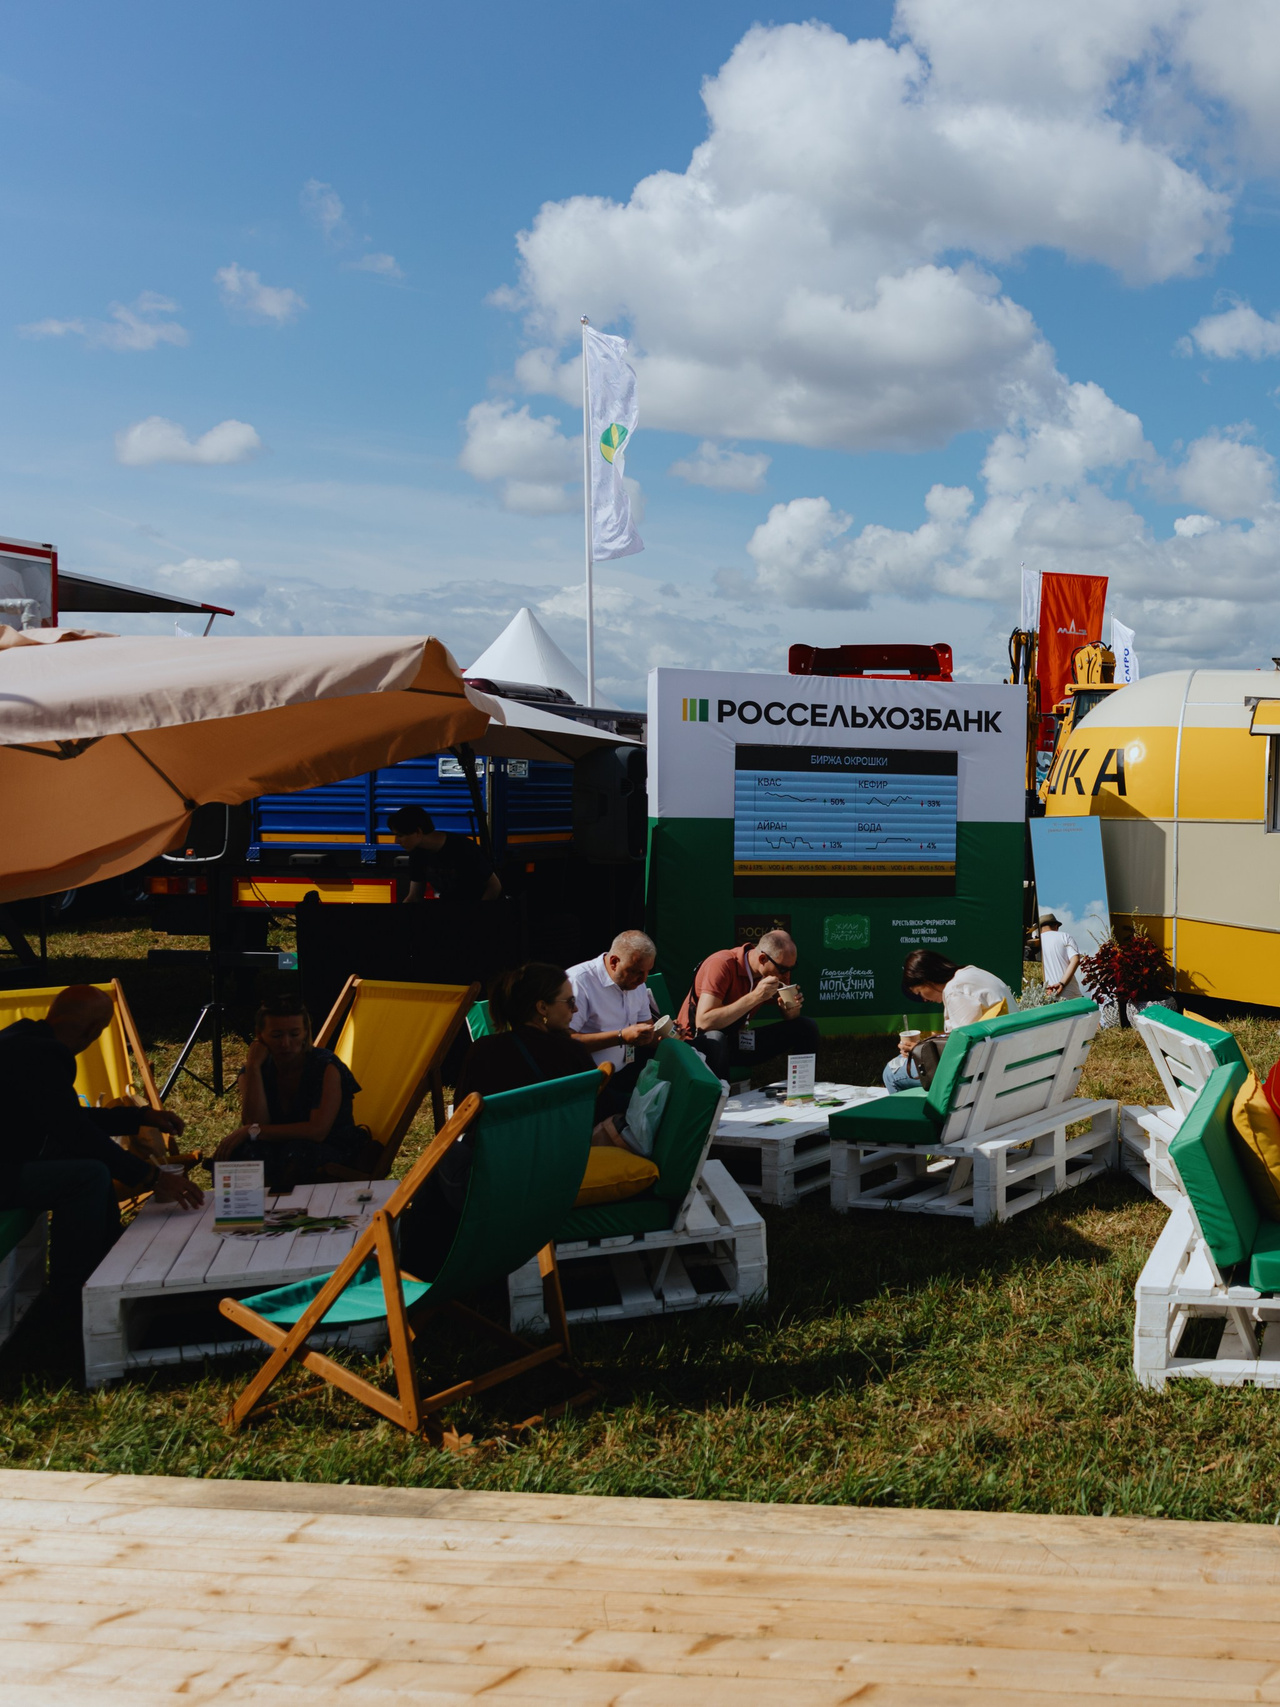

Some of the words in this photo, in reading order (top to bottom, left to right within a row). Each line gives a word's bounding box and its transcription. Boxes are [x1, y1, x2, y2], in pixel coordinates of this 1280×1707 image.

[717, 698, 1003, 733] РОССЕЛЬХОЗБАНК
[810, 754, 842, 765] БИРЖА
[843, 756, 888, 766] ОКРОШКИ
[757, 777, 782, 787] КВАС
[858, 780, 889, 789] КЕФИР
[830, 798, 846, 806] 50%
[756, 820, 788, 831] АЙРАН
[857, 823, 882, 832] ВОДА
[830, 841, 843, 849] 13%
[819, 991, 874, 1001] МАНУФАКТУРА
